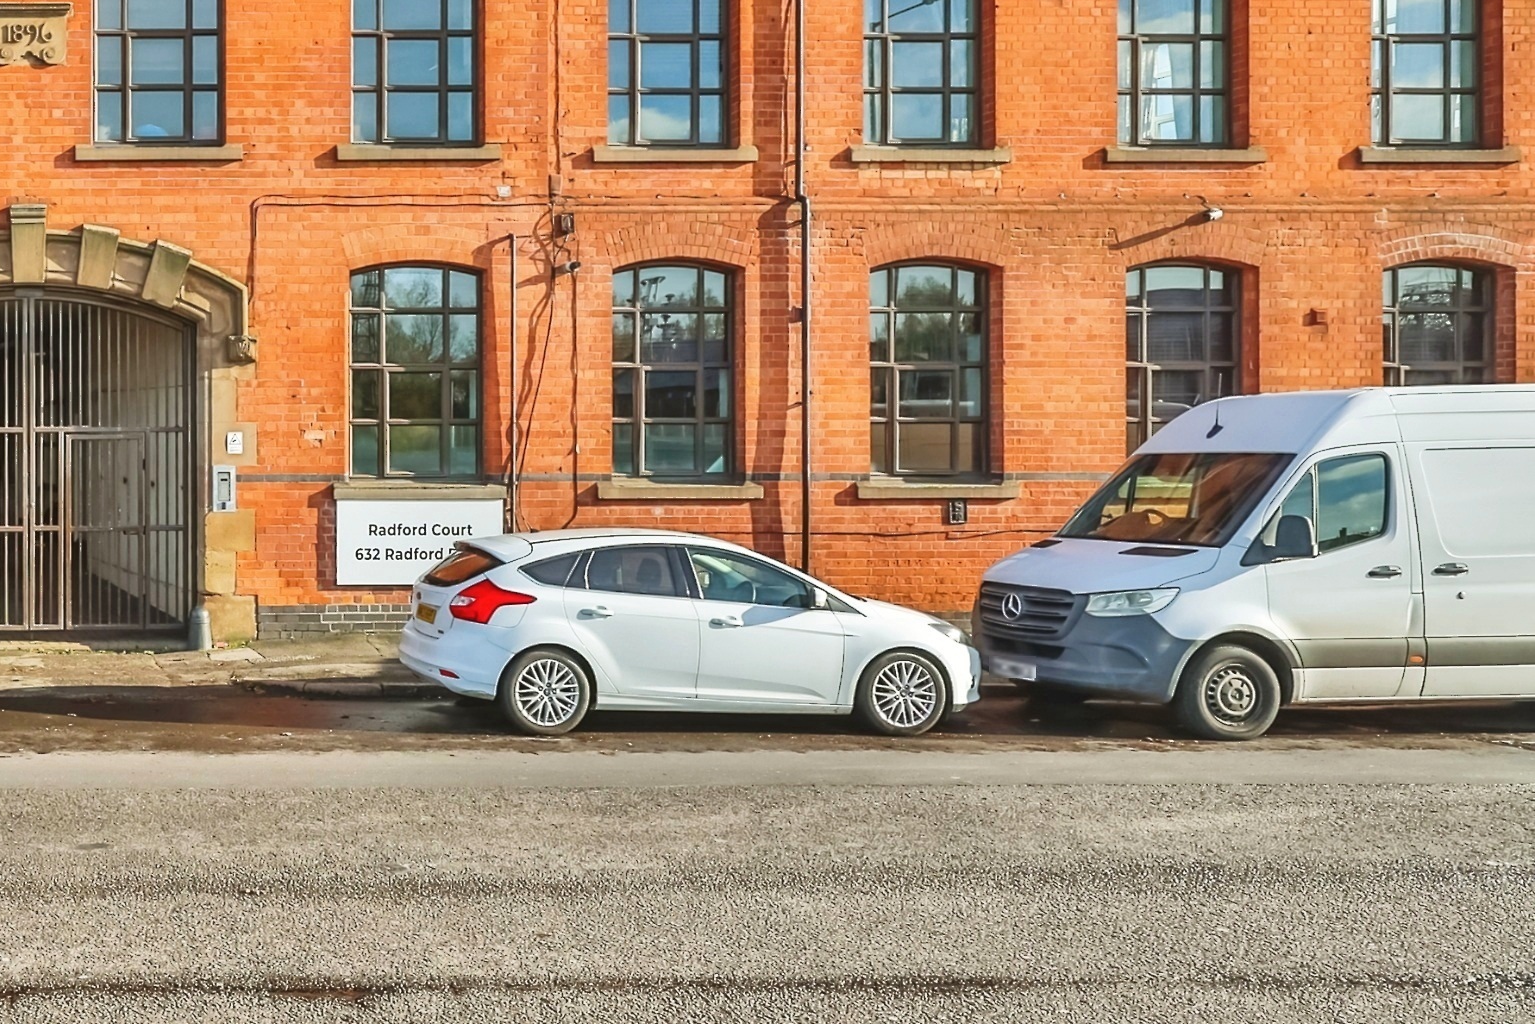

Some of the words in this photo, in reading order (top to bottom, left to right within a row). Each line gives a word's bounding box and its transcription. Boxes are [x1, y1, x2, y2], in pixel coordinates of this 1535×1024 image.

[1, 22, 52, 46] 1896
[368, 523, 427, 536] Radford
[431, 523, 473, 536] Court
[355, 547, 381, 561] 632
[385, 547, 444, 561] Radford
